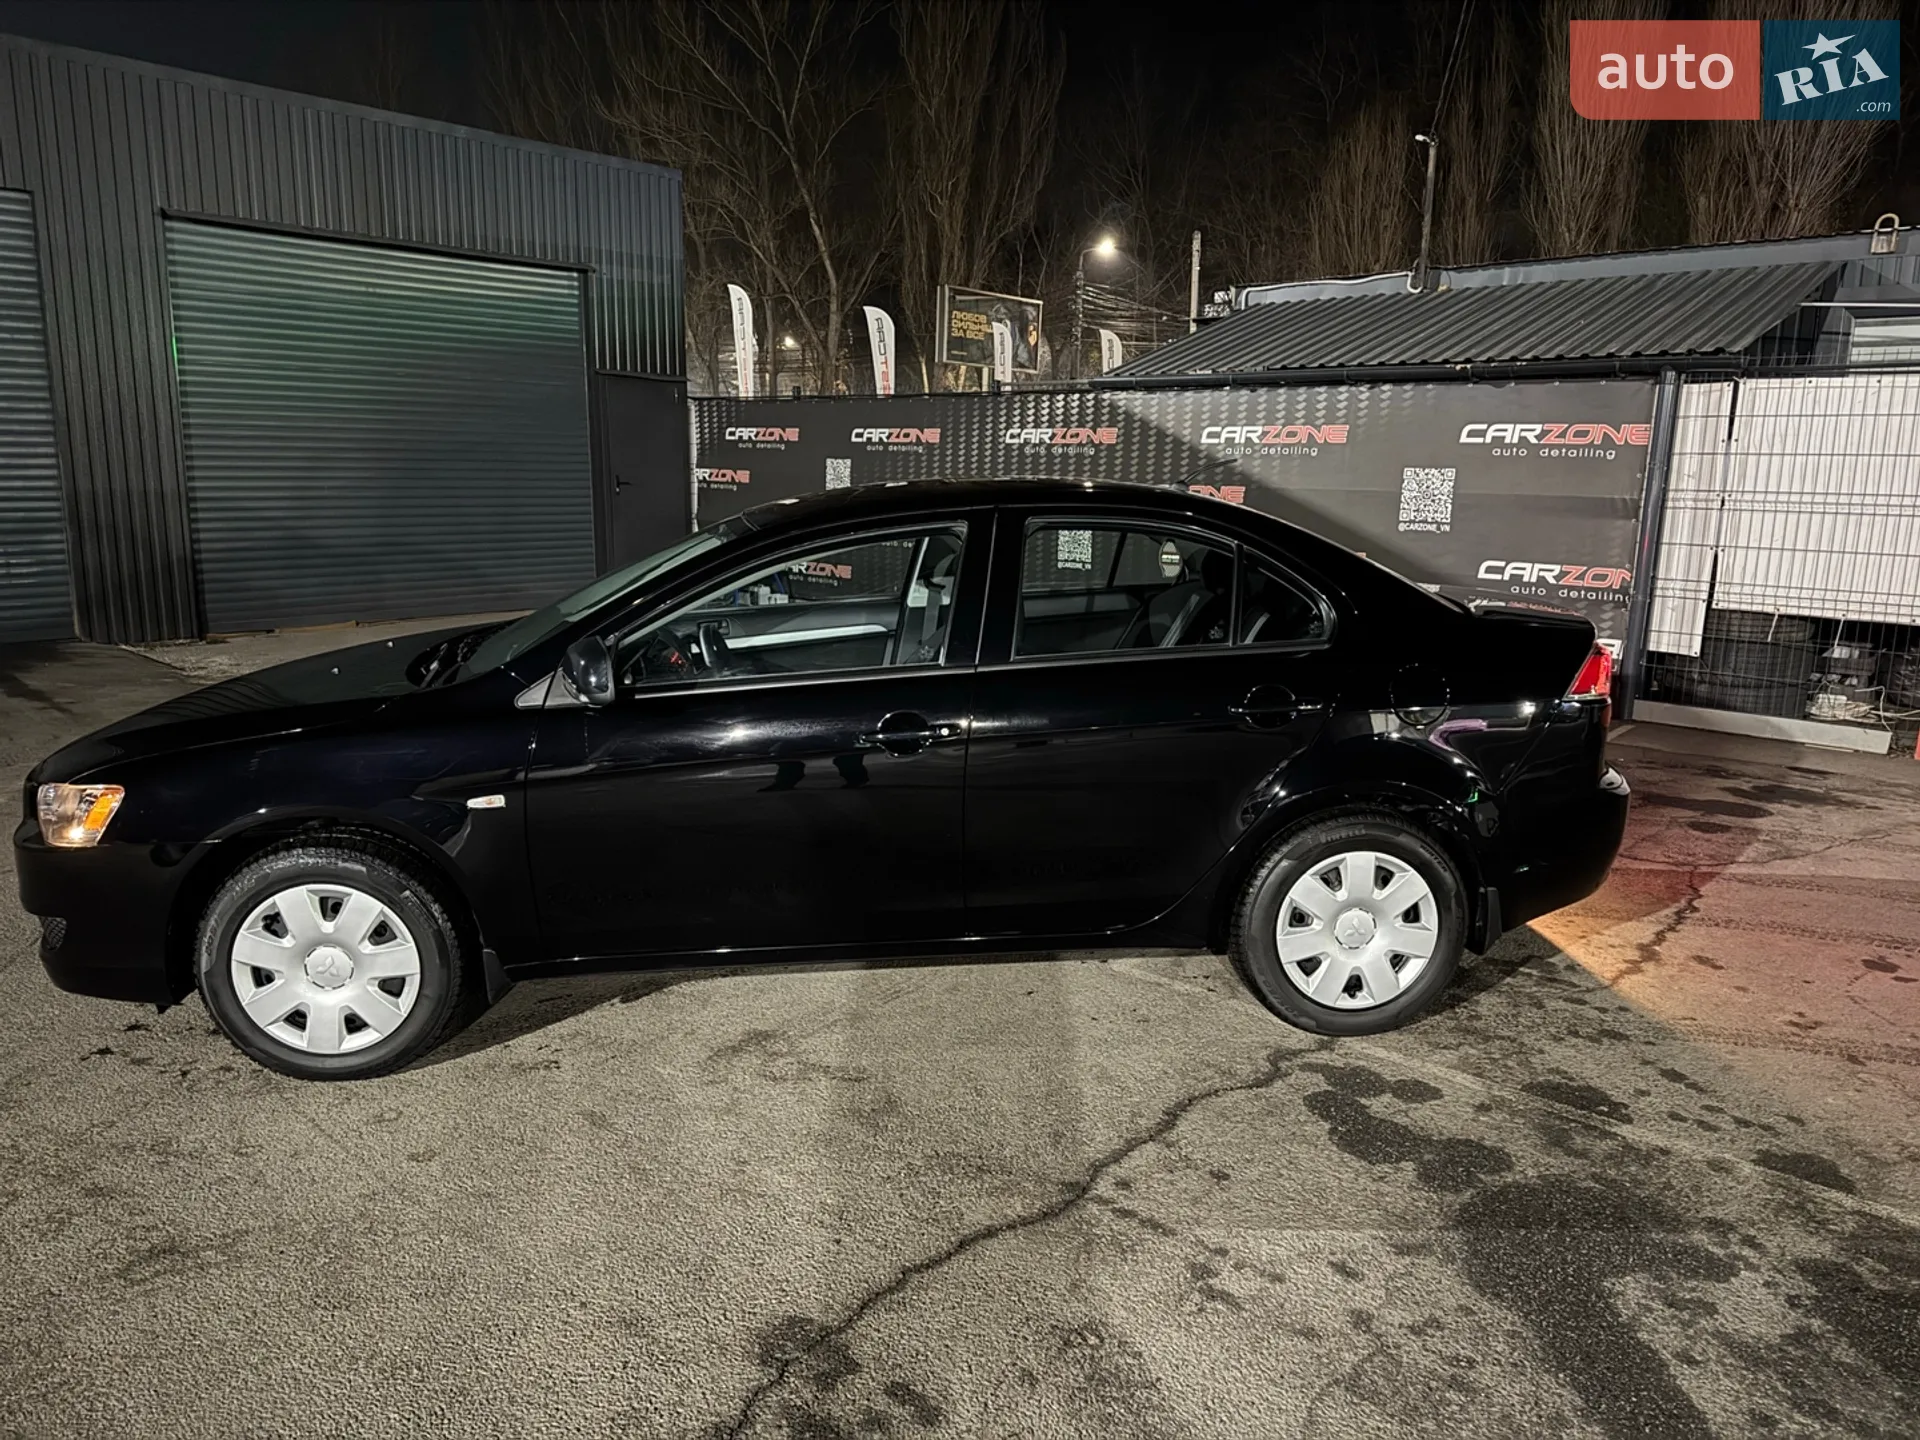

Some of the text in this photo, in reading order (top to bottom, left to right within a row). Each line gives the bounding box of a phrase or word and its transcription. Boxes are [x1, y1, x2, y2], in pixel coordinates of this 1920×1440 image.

[951, 310, 987, 323] ЛЮБОВ
[951, 319, 994, 333] СИЛЬНІШ
[951, 328, 985, 340] ЗА ВСЕ
[725, 427, 800, 442] CARZONE
[851, 428, 941, 443] CARZONE
[1005, 427, 1119, 444] CARZONE
[1200, 424, 1349, 444] CARZONE
[1459, 424, 1651, 445] CARZONE
[756, 442, 785, 451] detailing
[888, 444, 923, 453] detailing
[1024, 446, 1096, 455] auto detailing
[1225, 446, 1318, 456] auto detailing
[1492, 447, 1616, 460] auto detailing
[695, 468, 750, 484] ARZONE
[710, 483, 737, 491] detailing
[1397, 522, 1451, 534] @CARZONE_VN
[1477, 560, 1632, 589] CARZON
[1510, 585, 1547, 596] auto
